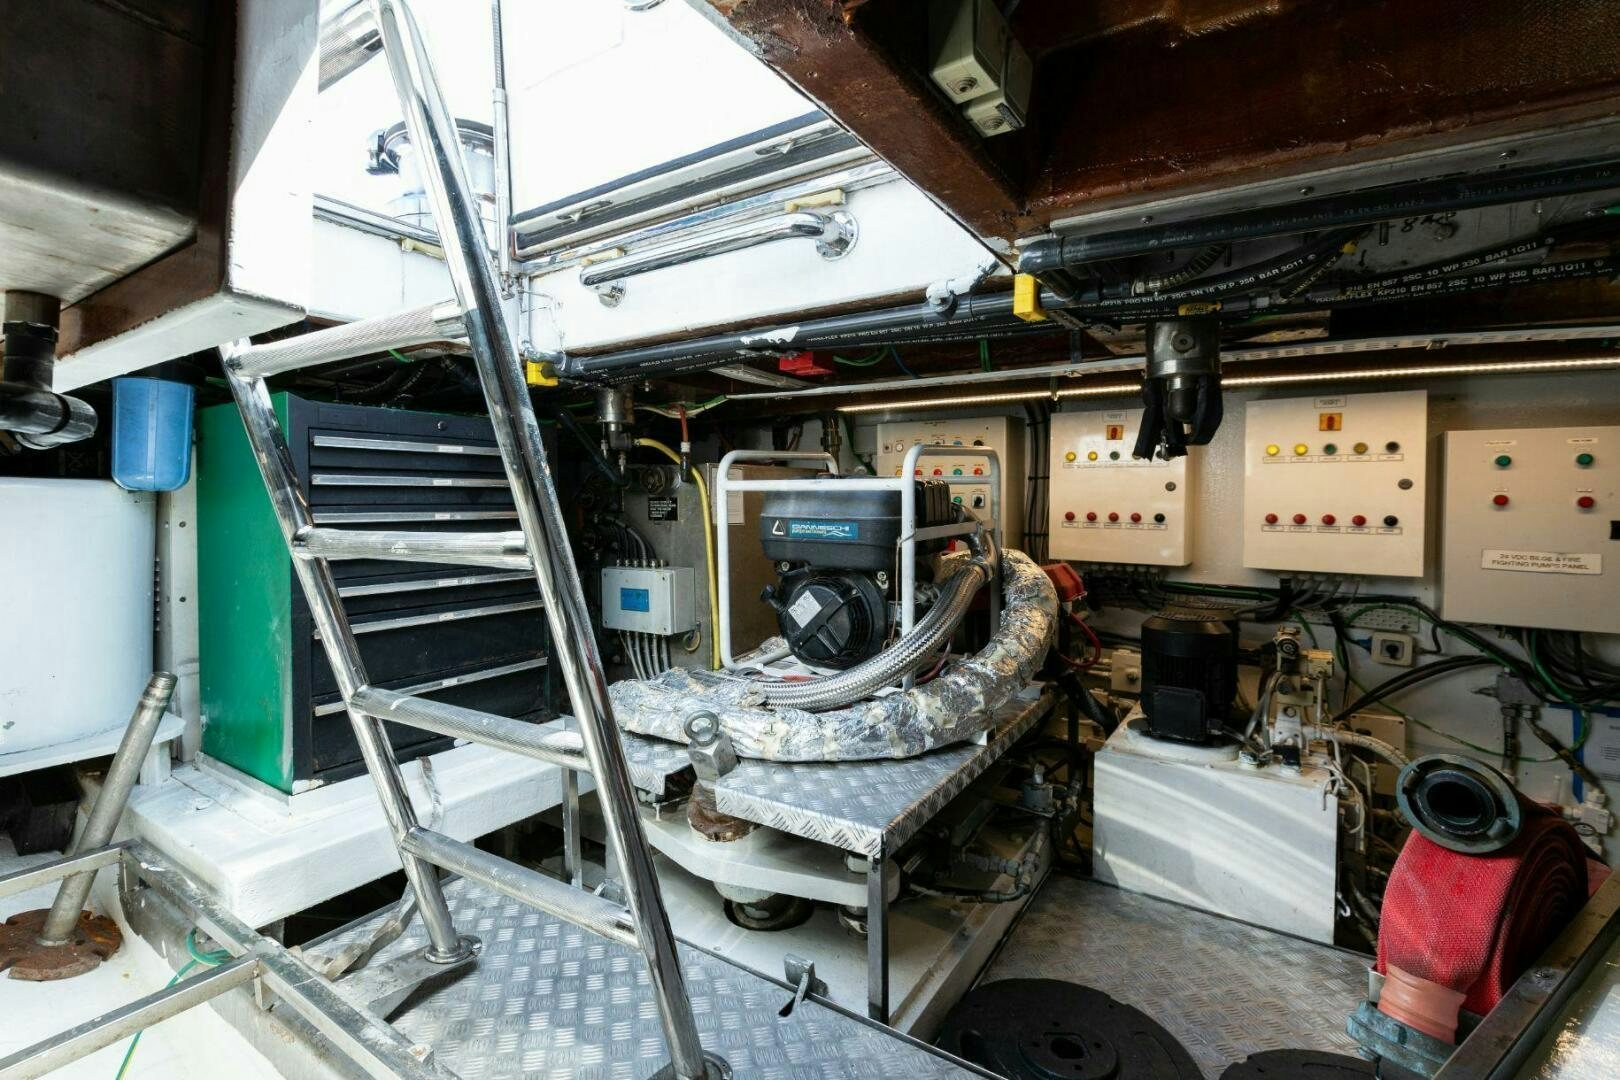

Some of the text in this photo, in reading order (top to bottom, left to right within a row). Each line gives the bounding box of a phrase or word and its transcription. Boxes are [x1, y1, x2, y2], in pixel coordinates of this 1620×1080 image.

[1258, 268, 1280, 280] BAR
[1366, 282, 1380, 290] EN
[1427, 269, 1439, 278] 10
[1442, 263, 1459, 274] WP
[1462, 257, 1480, 268] 330
[1485, 249, 1509, 262] BAR
[1410, 284, 1425, 293] EN
[1426, 281, 1443, 291] 857
[1447, 278, 1469, 288] 2SC
[1473, 275, 1486, 284] 10
[1489, 272, 1507, 282] WP
[1508, 269, 1528, 280] 330
[1532, 265, 1556, 276] BAR
[1511, 553, 1528, 561] VDC
[1491, 559, 1590, 570] FIGHTING PUMPS PANEL
